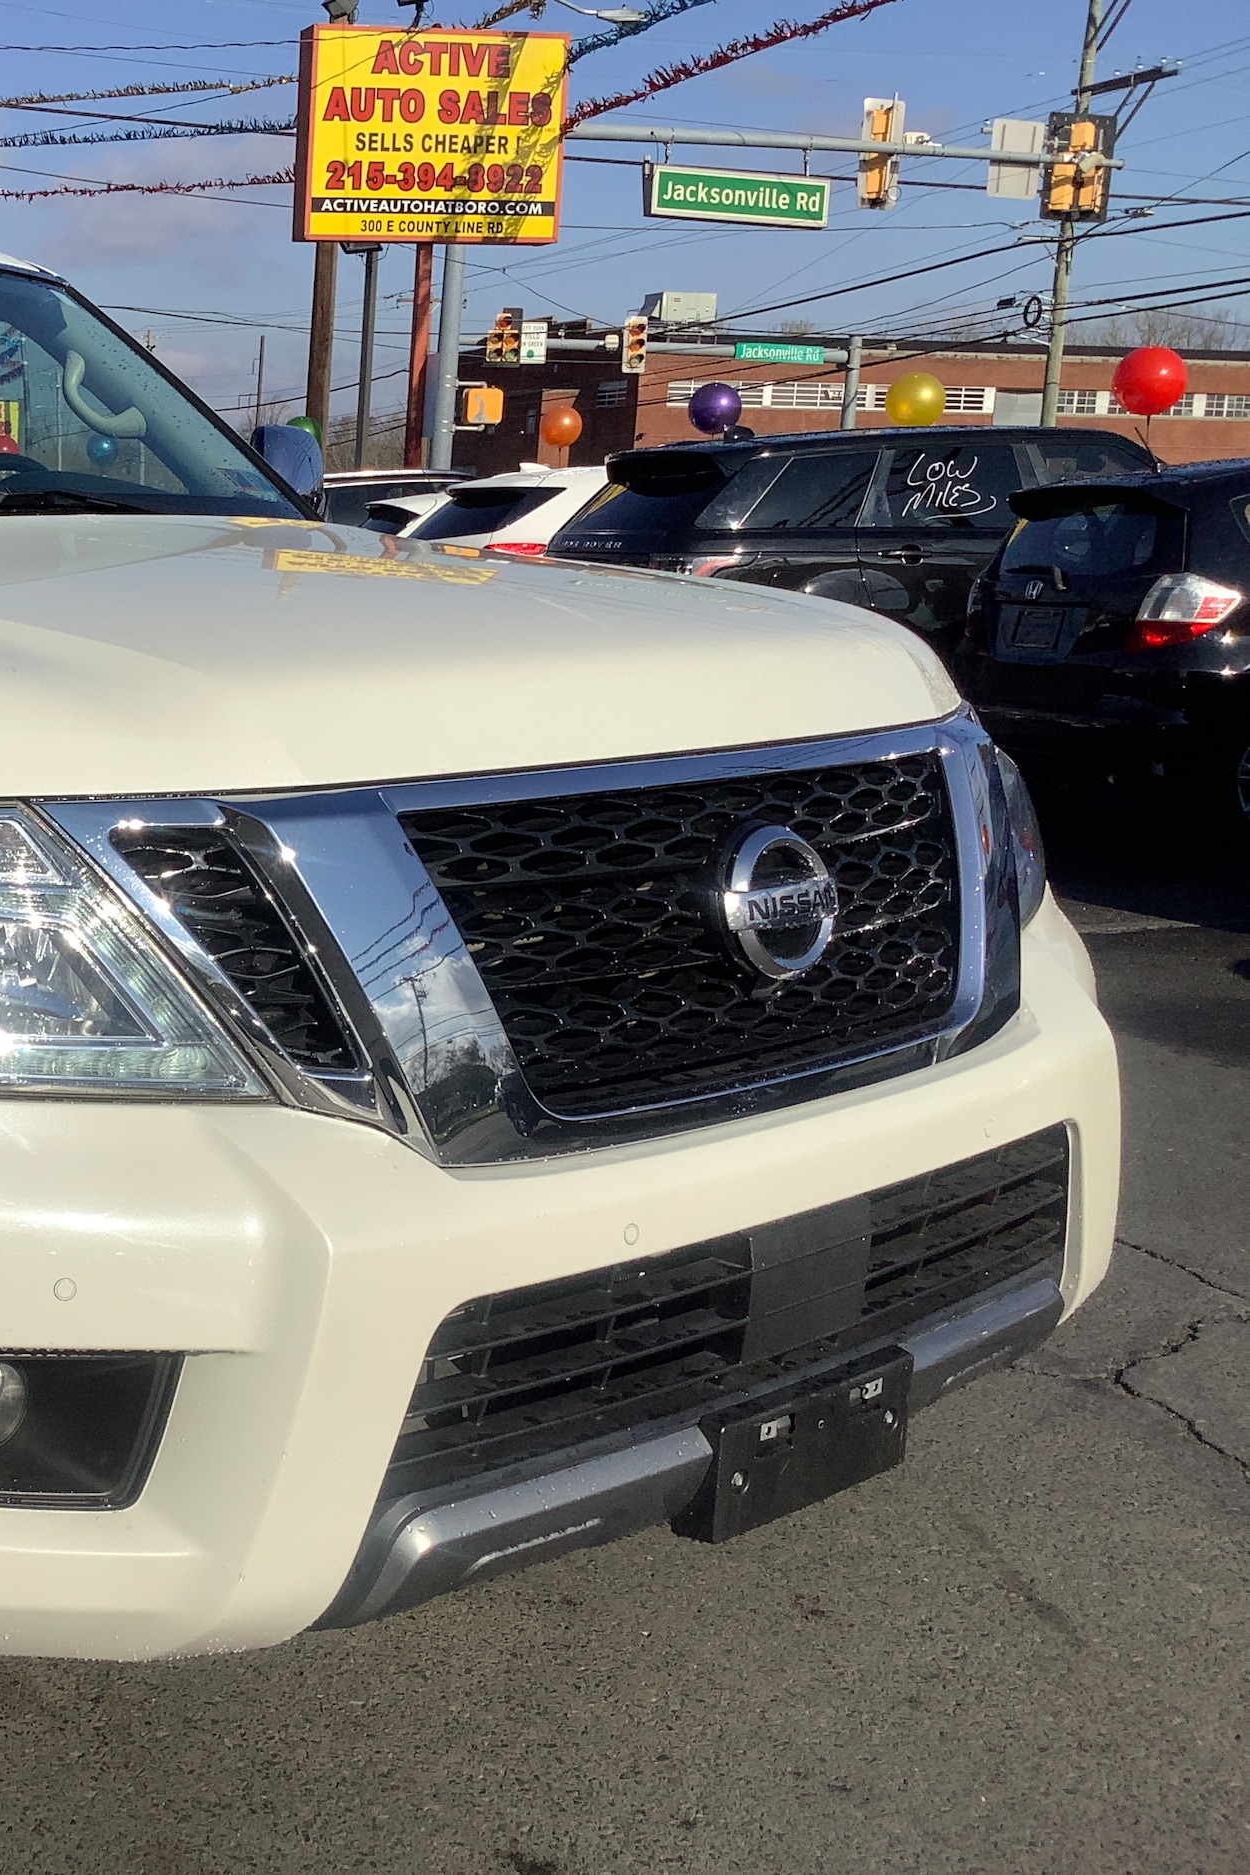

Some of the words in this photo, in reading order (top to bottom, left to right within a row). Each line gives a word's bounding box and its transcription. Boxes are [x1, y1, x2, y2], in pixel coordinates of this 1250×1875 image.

[371, 40, 511, 78] ACTIVE
[323, 86, 425, 123] AUTO
[438, 90, 553, 127] SALES
[355, 132, 414, 153] SELLS
[421, 133, 509, 154] CHEAPER
[325, 160, 543, 194] 215-394-8922
[320, 199, 543, 215] ACTIVEAUTOHATBORO.COM
[662, 181, 790, 209] Jacksonville
[795, 191, 820, 212] Rd
[360, 220, 385, 232] 300
[387, 220, 394, 232] E
[398, 220, 451, 233] COUNTY
[454, 221, 482, 233] LINE
[488, 222, 504, 234] RD
[740, 344, 804, 360] Jacksonville
[806, 348, 820, 361] Rd
[907, 453, 978, 486] LOW
[747, 885, 838, 921] NISSAN
